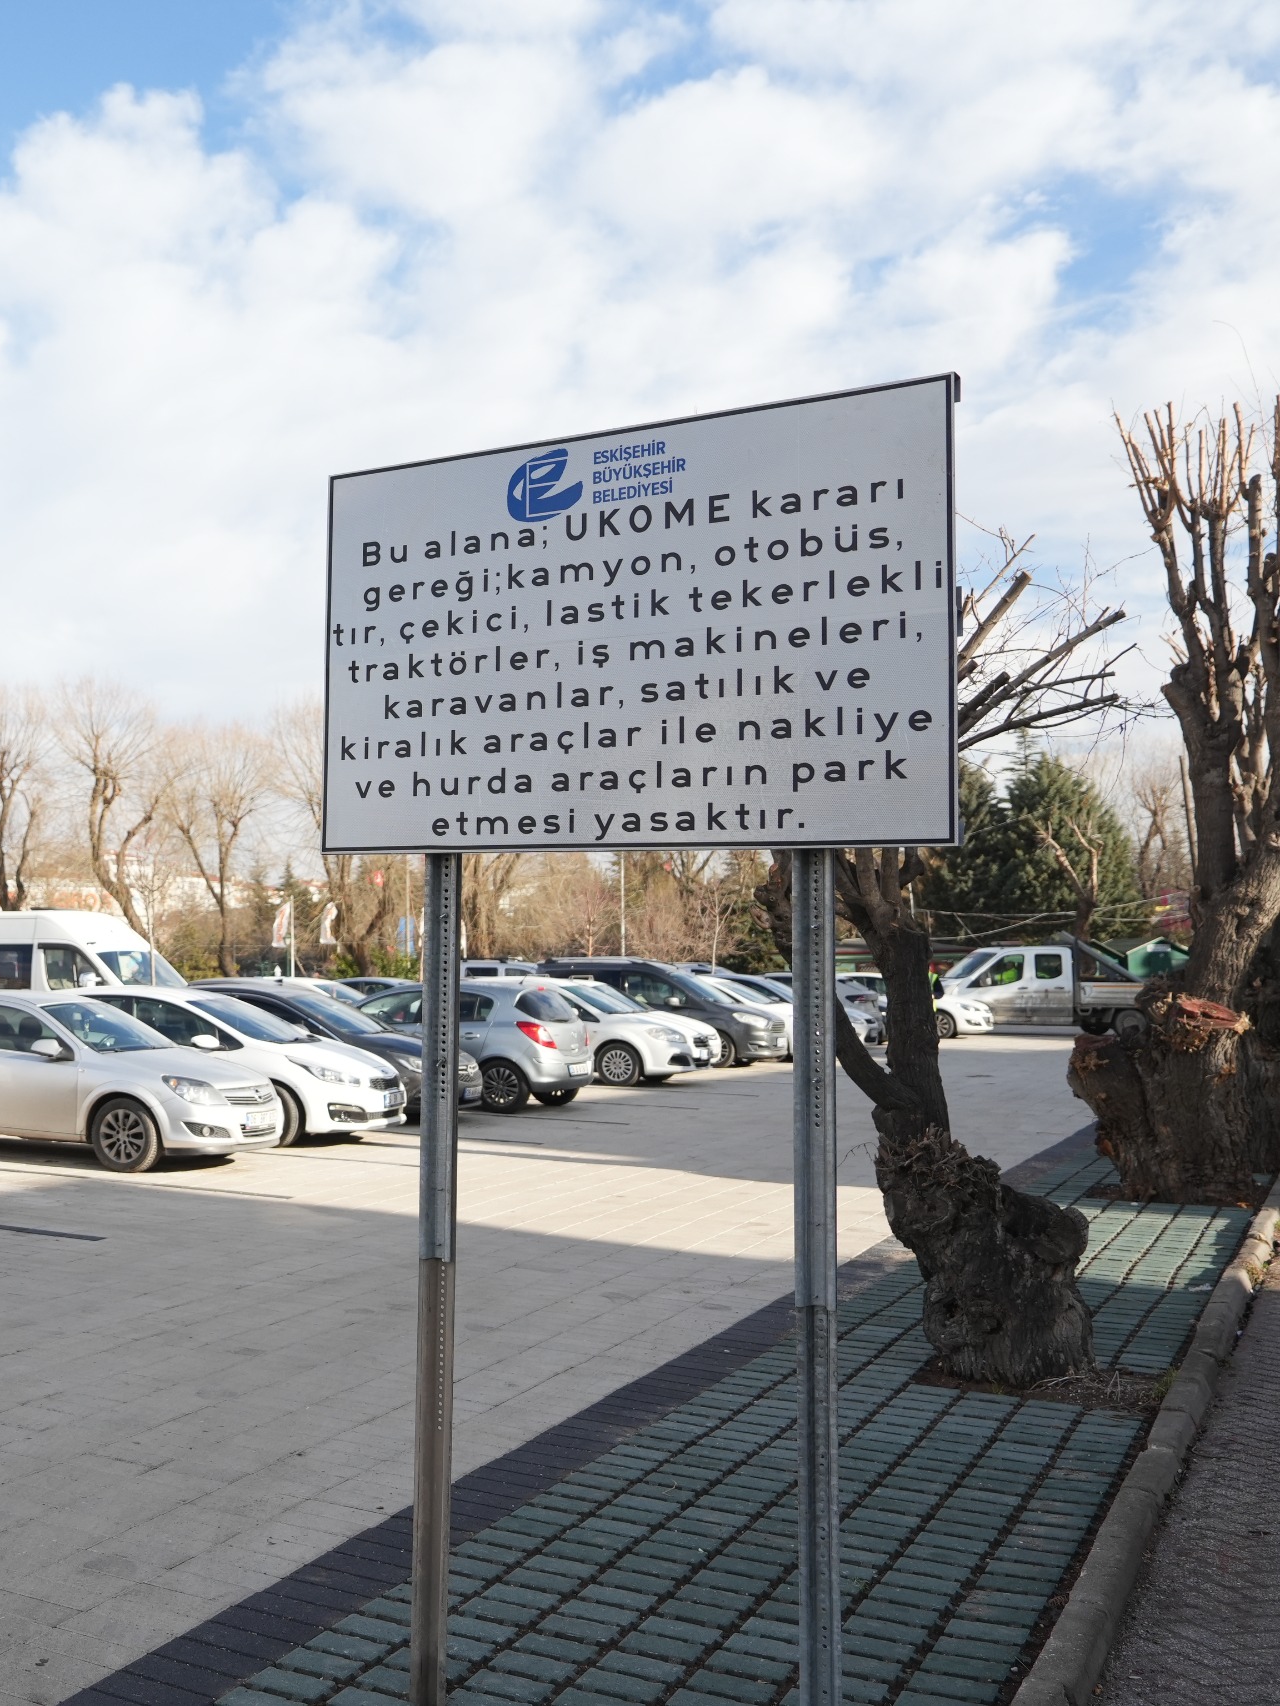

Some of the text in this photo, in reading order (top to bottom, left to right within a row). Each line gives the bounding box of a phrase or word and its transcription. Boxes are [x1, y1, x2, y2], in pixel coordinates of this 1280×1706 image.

[592, 457, 686, 485] BÜYÜKŞEHİR
[593, 440, 666, 465] ESKİŞEHİR
[592, 477, 673, 504] BELEDİYESİ
[362, 478, 904, 568] Bu alana; UKOME kararı
[714, 523, 903, 567] otobüs,
[332, 560, 942, 647] tır, çekici, lastik tekerlekli
[348, 610, 922, 684] traktörler, iş makineleri,
[384, 665, 871, 720] karavanlar, satılık ve
[340, 706, 933, 761] kiralık araçlar ile nakliye
[354, 749, 908, 799] ve hurda araçların park
[431, 802, 805, 842] etmesi yasaktır.
